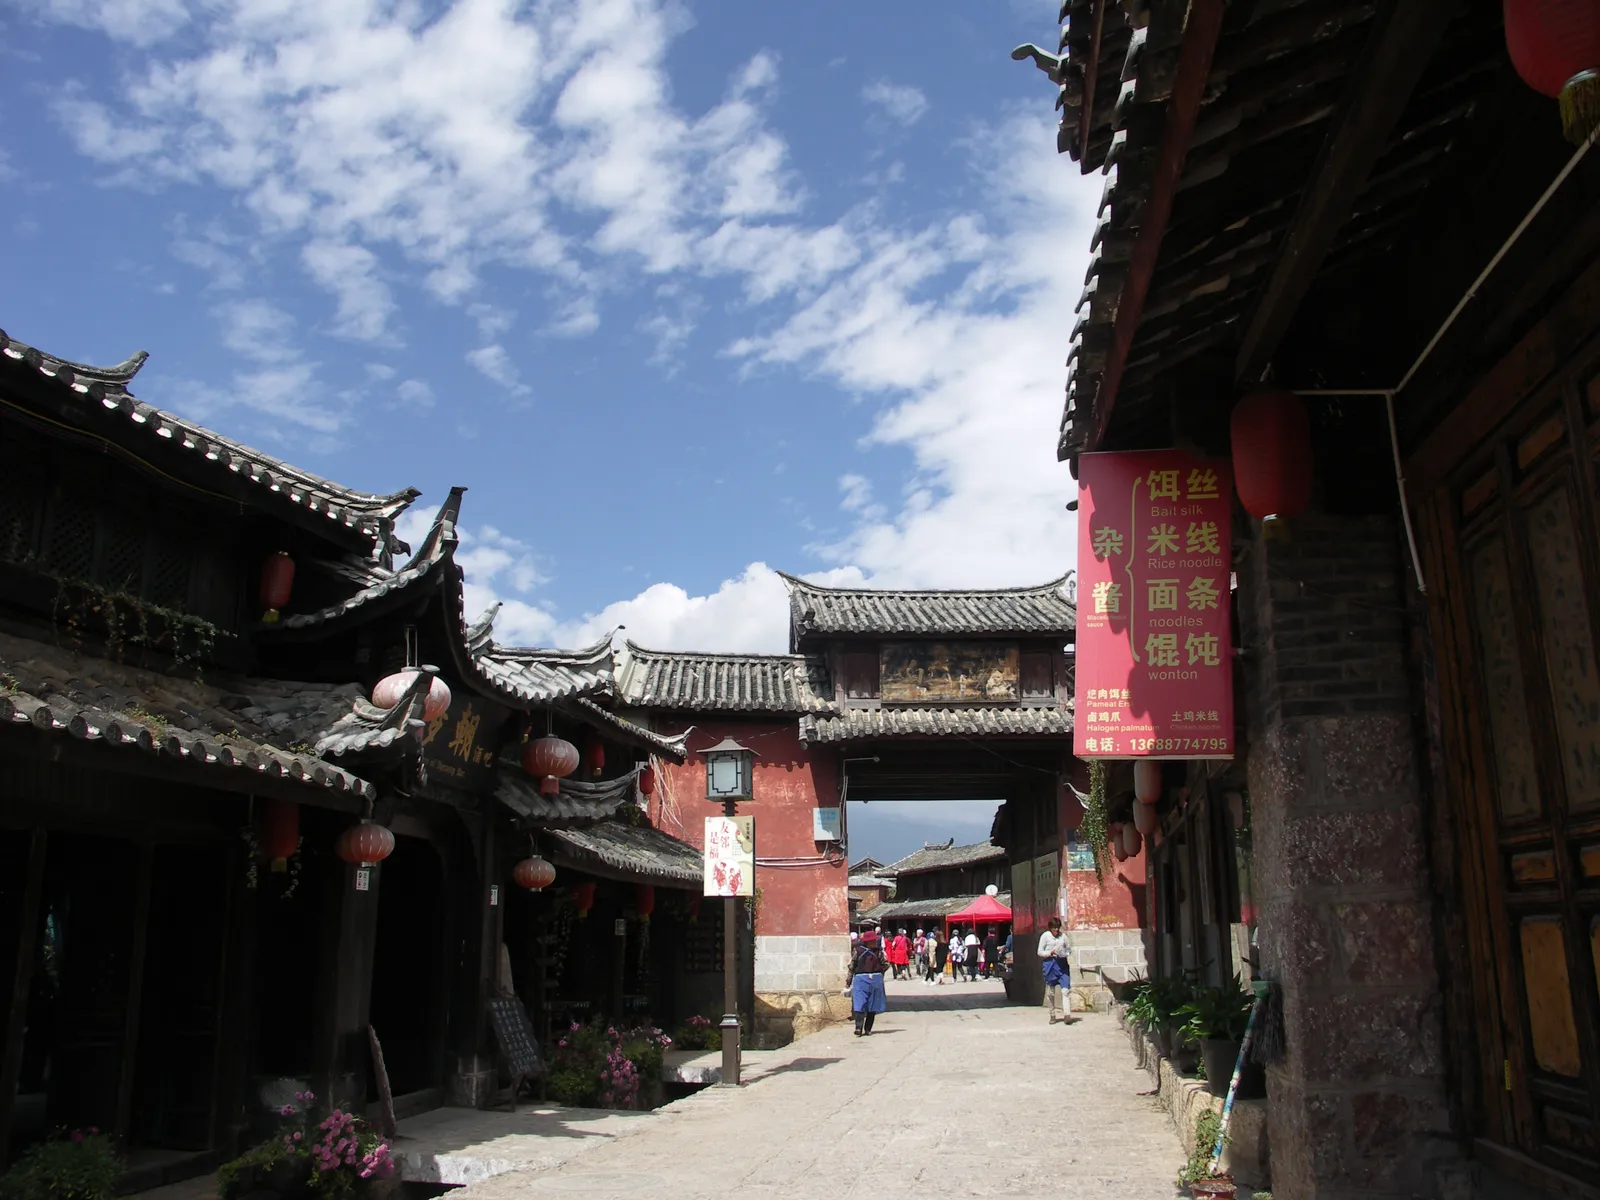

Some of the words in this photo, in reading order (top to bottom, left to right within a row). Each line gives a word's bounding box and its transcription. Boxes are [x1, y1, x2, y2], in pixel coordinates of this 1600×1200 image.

[1146, 468, 1220, 502] 饵丝
[1180, 504, 1203, 516] silk
[1146, 521, 1221, 557] 米线
[1148, 558, 1176, 569] Rice
[1179, 556, 1222, 568] noodle
[1145, 576, 1220, 612] 面条
[1149, 616, 1203, 628] noodles
[1144, 632, 1220, 667] 馄饨
[1148, 669, 1198, 681] wonton
[1171, 711, 1219, 722] 土鸡米线
[1086, 724, 1120, 733] Halogen
[1129, 738, 1227, 751] 13688774795
